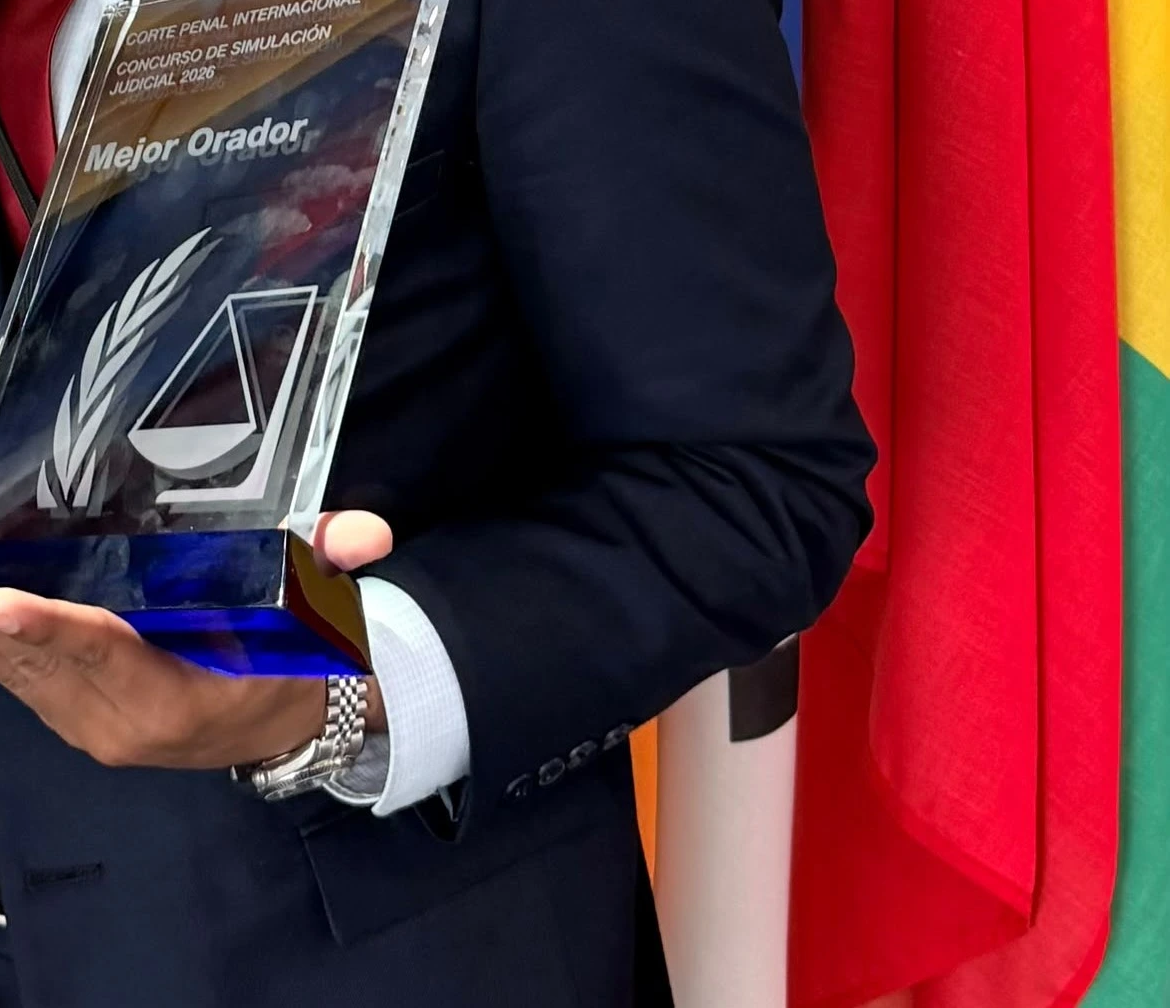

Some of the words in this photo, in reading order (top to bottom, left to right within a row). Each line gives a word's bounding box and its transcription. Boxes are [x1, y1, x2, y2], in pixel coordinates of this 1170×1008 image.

[116, 49, 203, 76] CONCURSO
[205, 43, 229, 60] DE
[230, 23, 332, 56] SIMULACIÓN
[126, 24, 177, 46] CORTE
[179, 15, 228, 36] PENAL
[109, 72, 176, 95] JUDICIAL
[179, 64, 216, 84] 2026
[84, 136, 180, 173] Mejor
[187, 117, 309, 157] Orador
